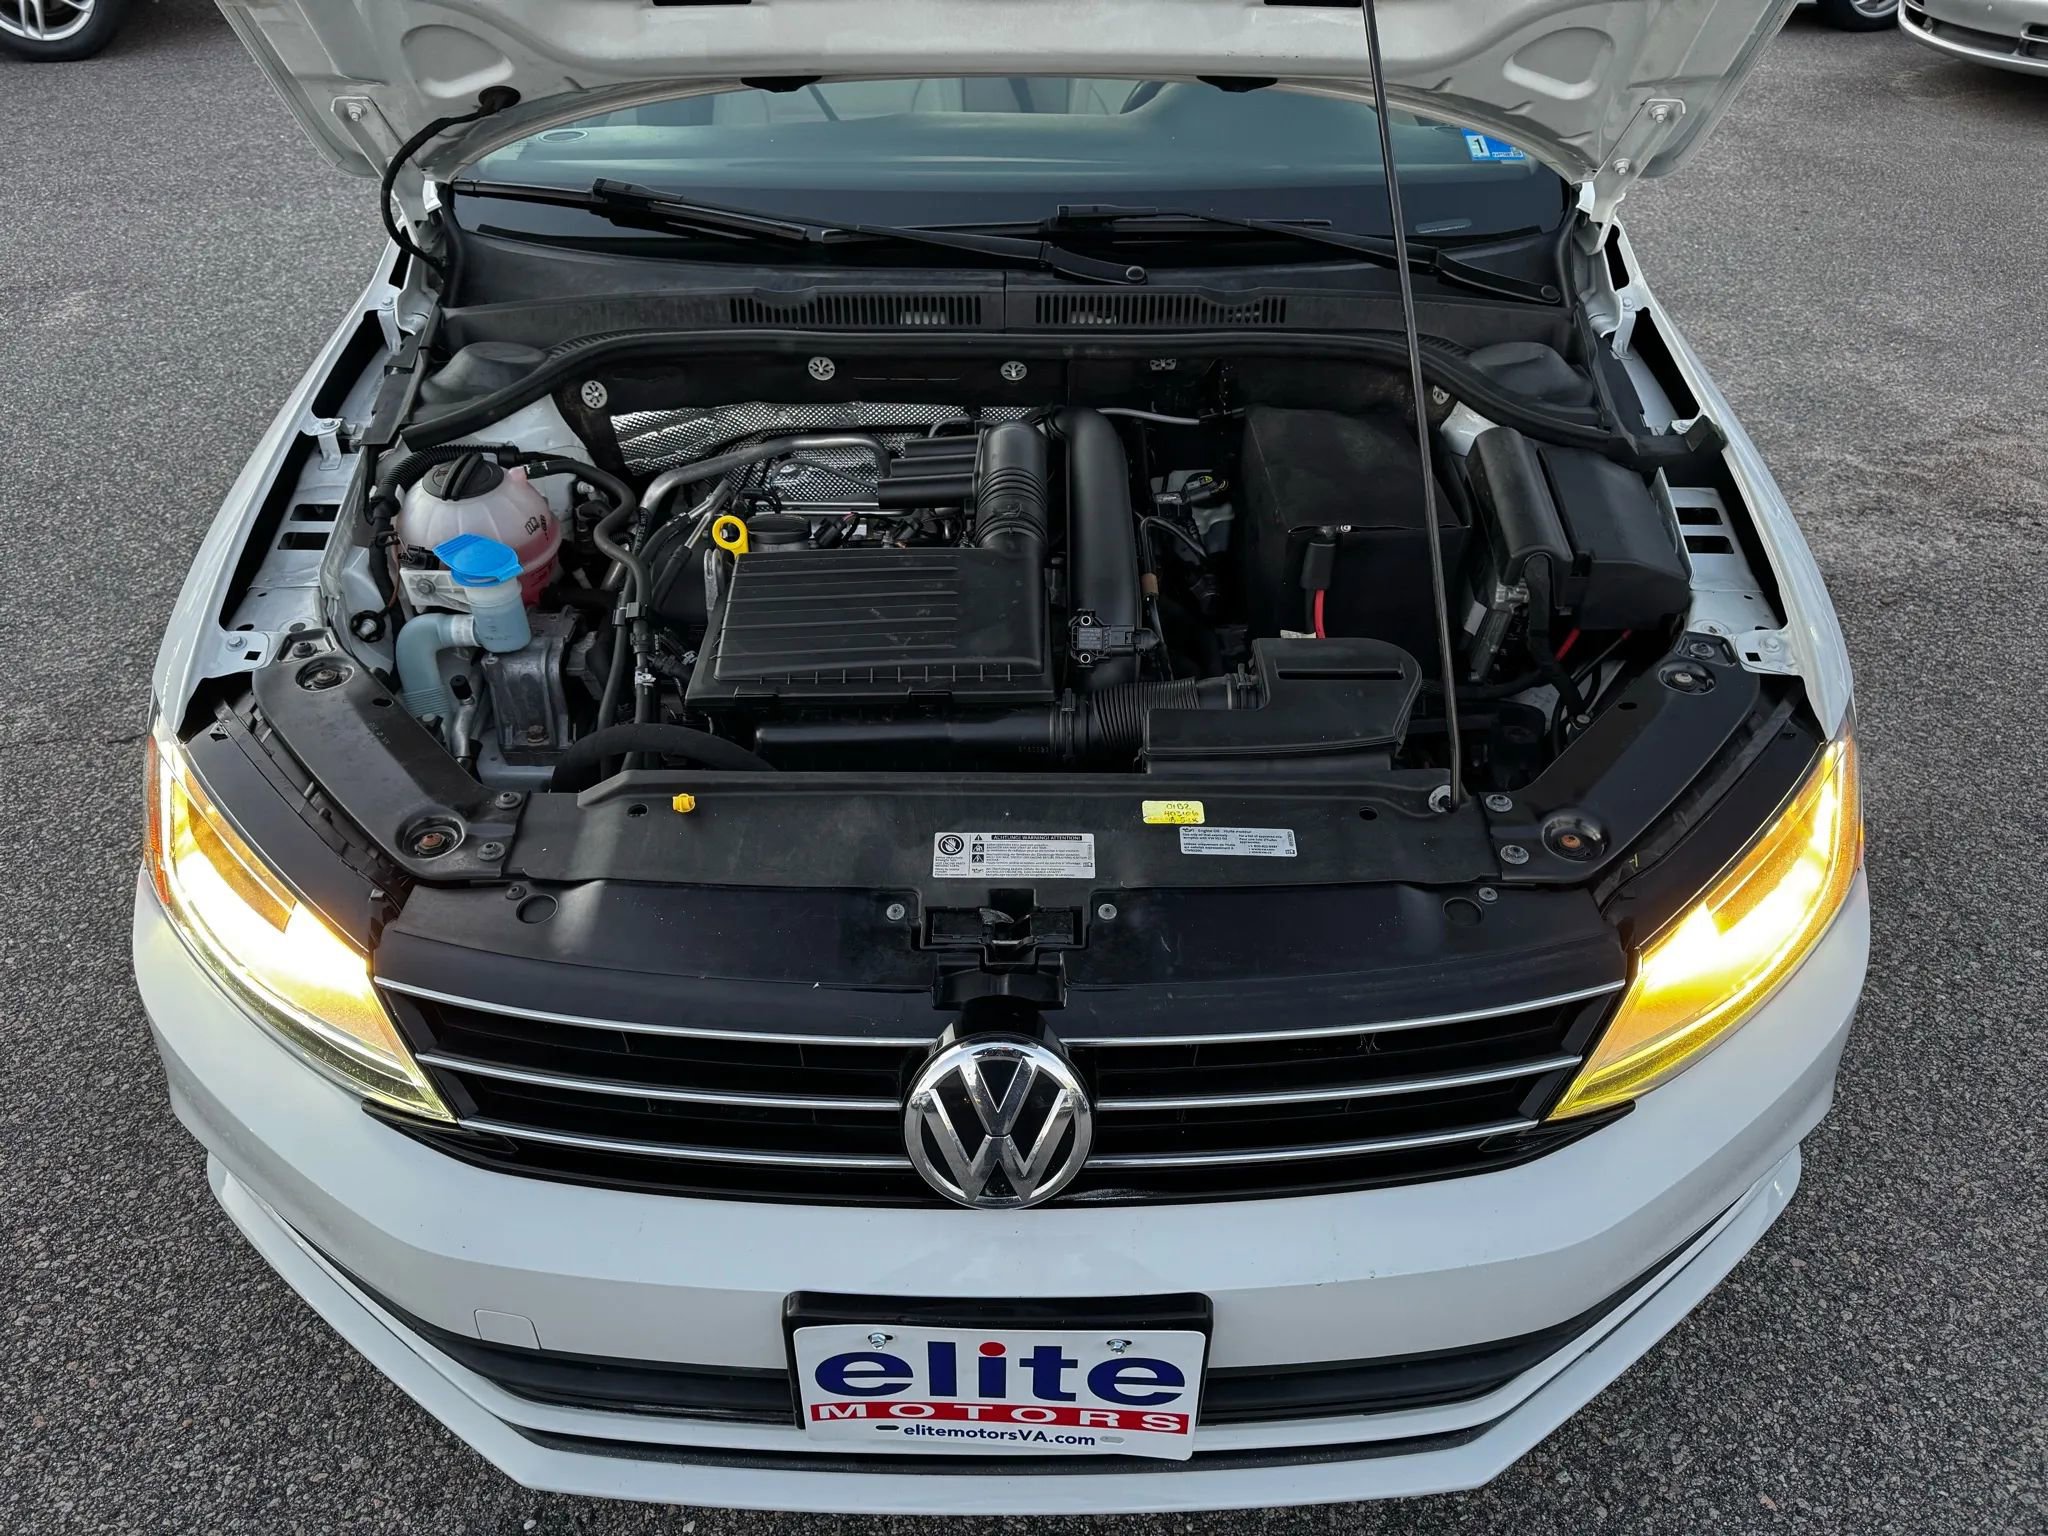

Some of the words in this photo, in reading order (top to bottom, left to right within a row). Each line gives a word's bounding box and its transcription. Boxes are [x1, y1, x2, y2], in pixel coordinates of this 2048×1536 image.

[1474, 138, 1484, 153] 1
[912, 1046, 1086, 1207] VW
[814, 1341, 1186, 1407] elite
[818, 1403, 1182, 1432] MOTORS
[903, 1424, 1096, 1446] elitemotorsVA.com
